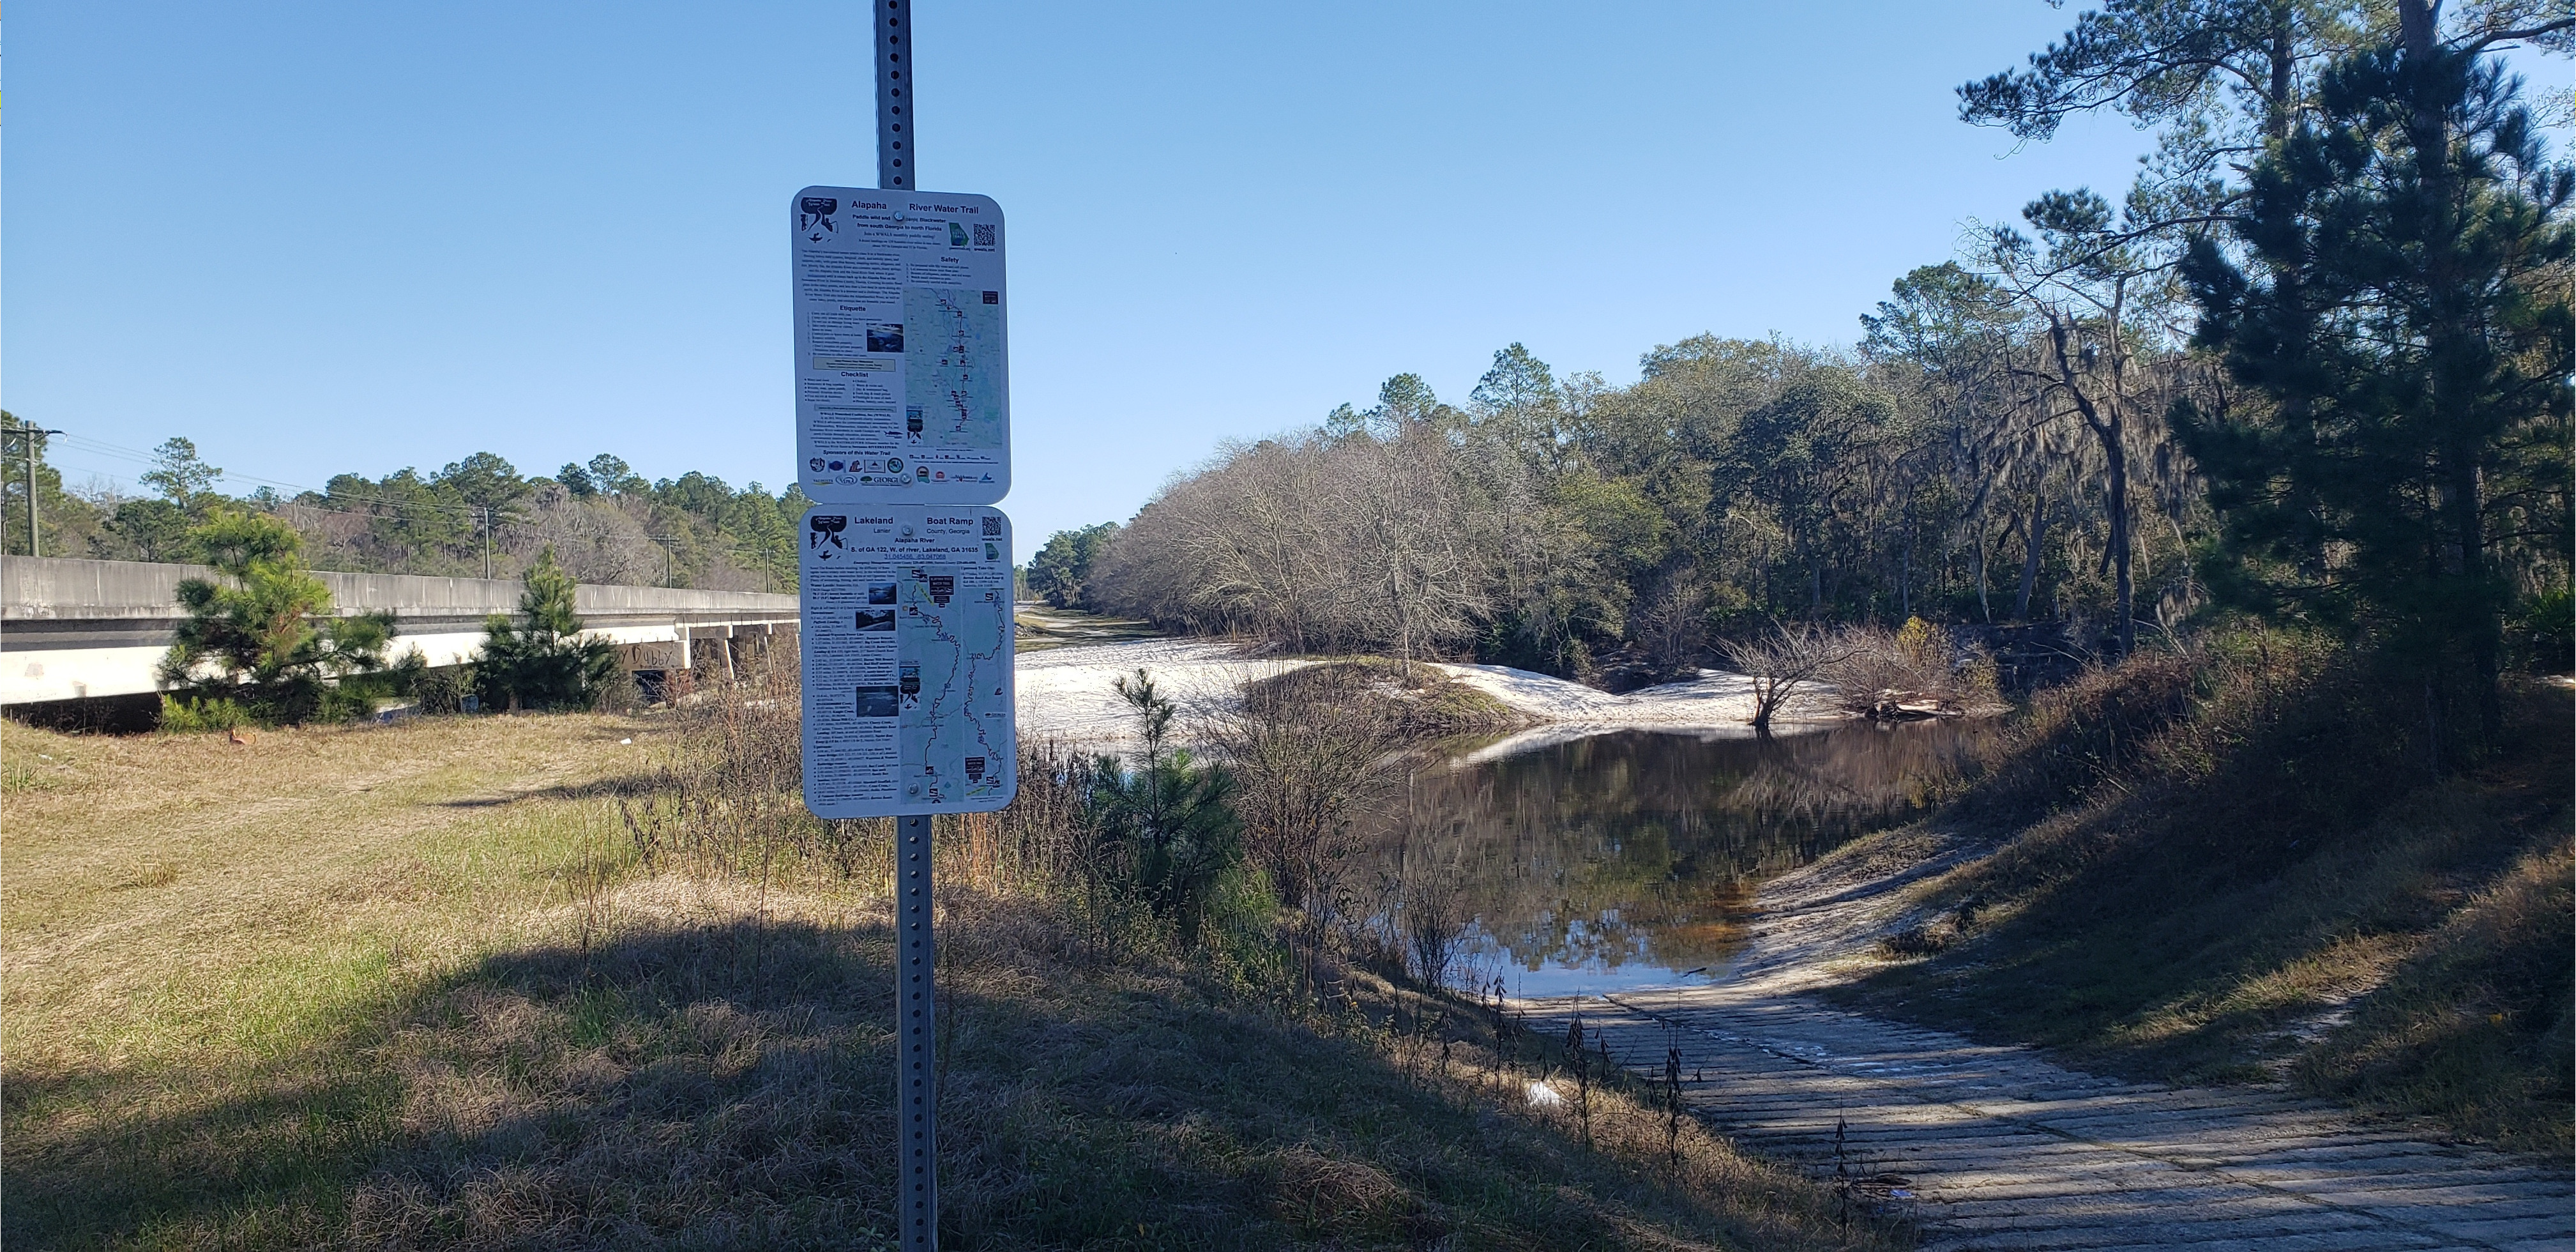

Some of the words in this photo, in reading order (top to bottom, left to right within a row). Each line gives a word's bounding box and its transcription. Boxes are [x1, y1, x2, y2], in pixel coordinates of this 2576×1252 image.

[851, 201, 888, 210] Alapaha
[909, 203, 932, 211] River
[934, 204, 959, 213] Water
[960, 206, 979, 214] Trail
[927, 517, 947, 525] Boat
[949, 517, 974, 526] Ramp
